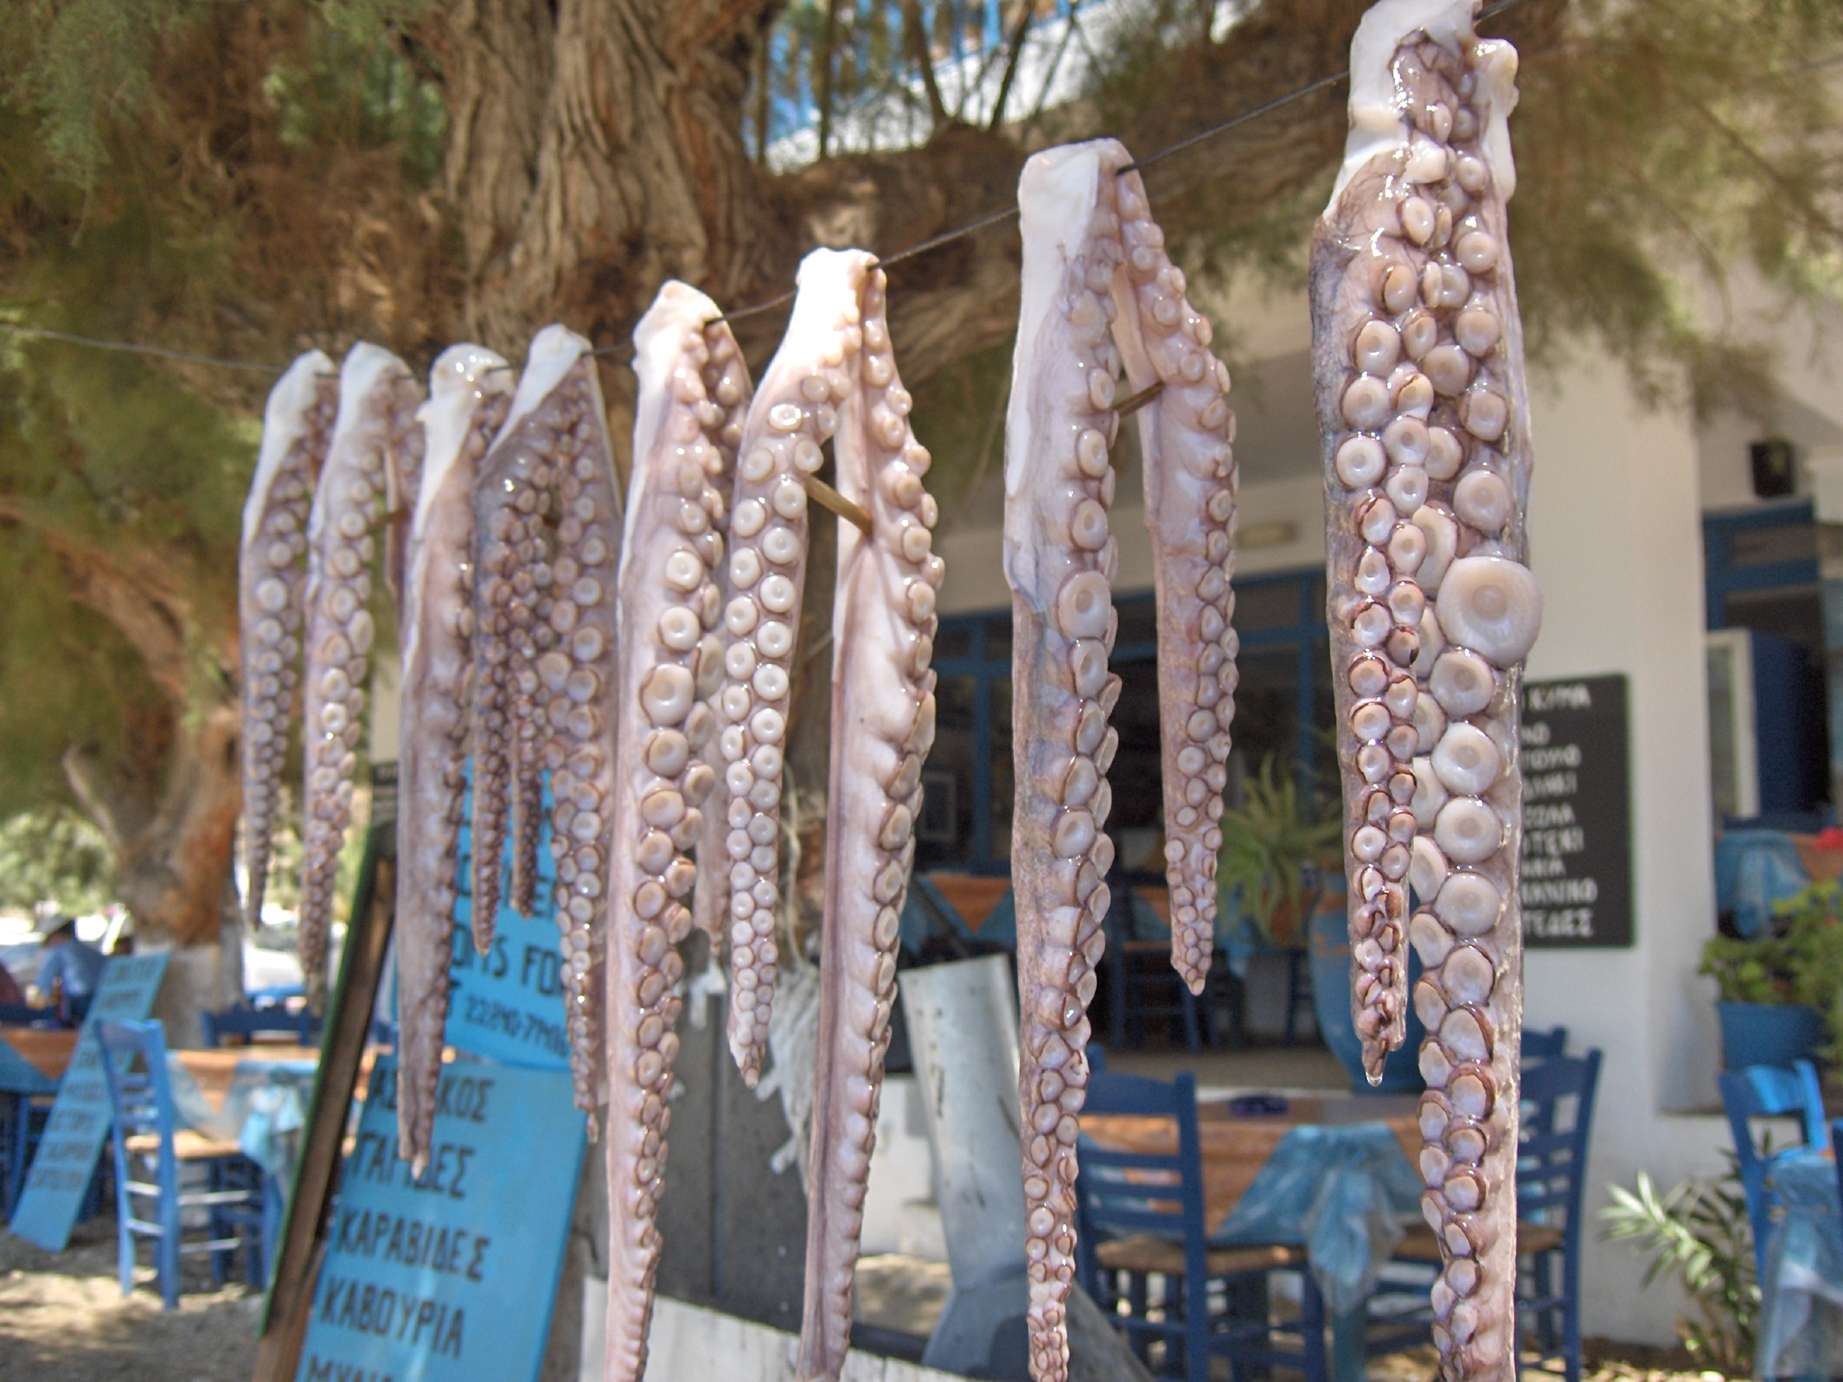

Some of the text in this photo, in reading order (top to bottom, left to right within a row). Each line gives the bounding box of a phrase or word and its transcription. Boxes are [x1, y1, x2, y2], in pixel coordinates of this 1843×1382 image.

[521, 944, 566, 997] FO
[336, 1205, 491, 1284] ΚΑΡΑΒΙΔΕΣ
[320, 1276, 465, 1360] ΚΑΒΟΥΡΙΑ
